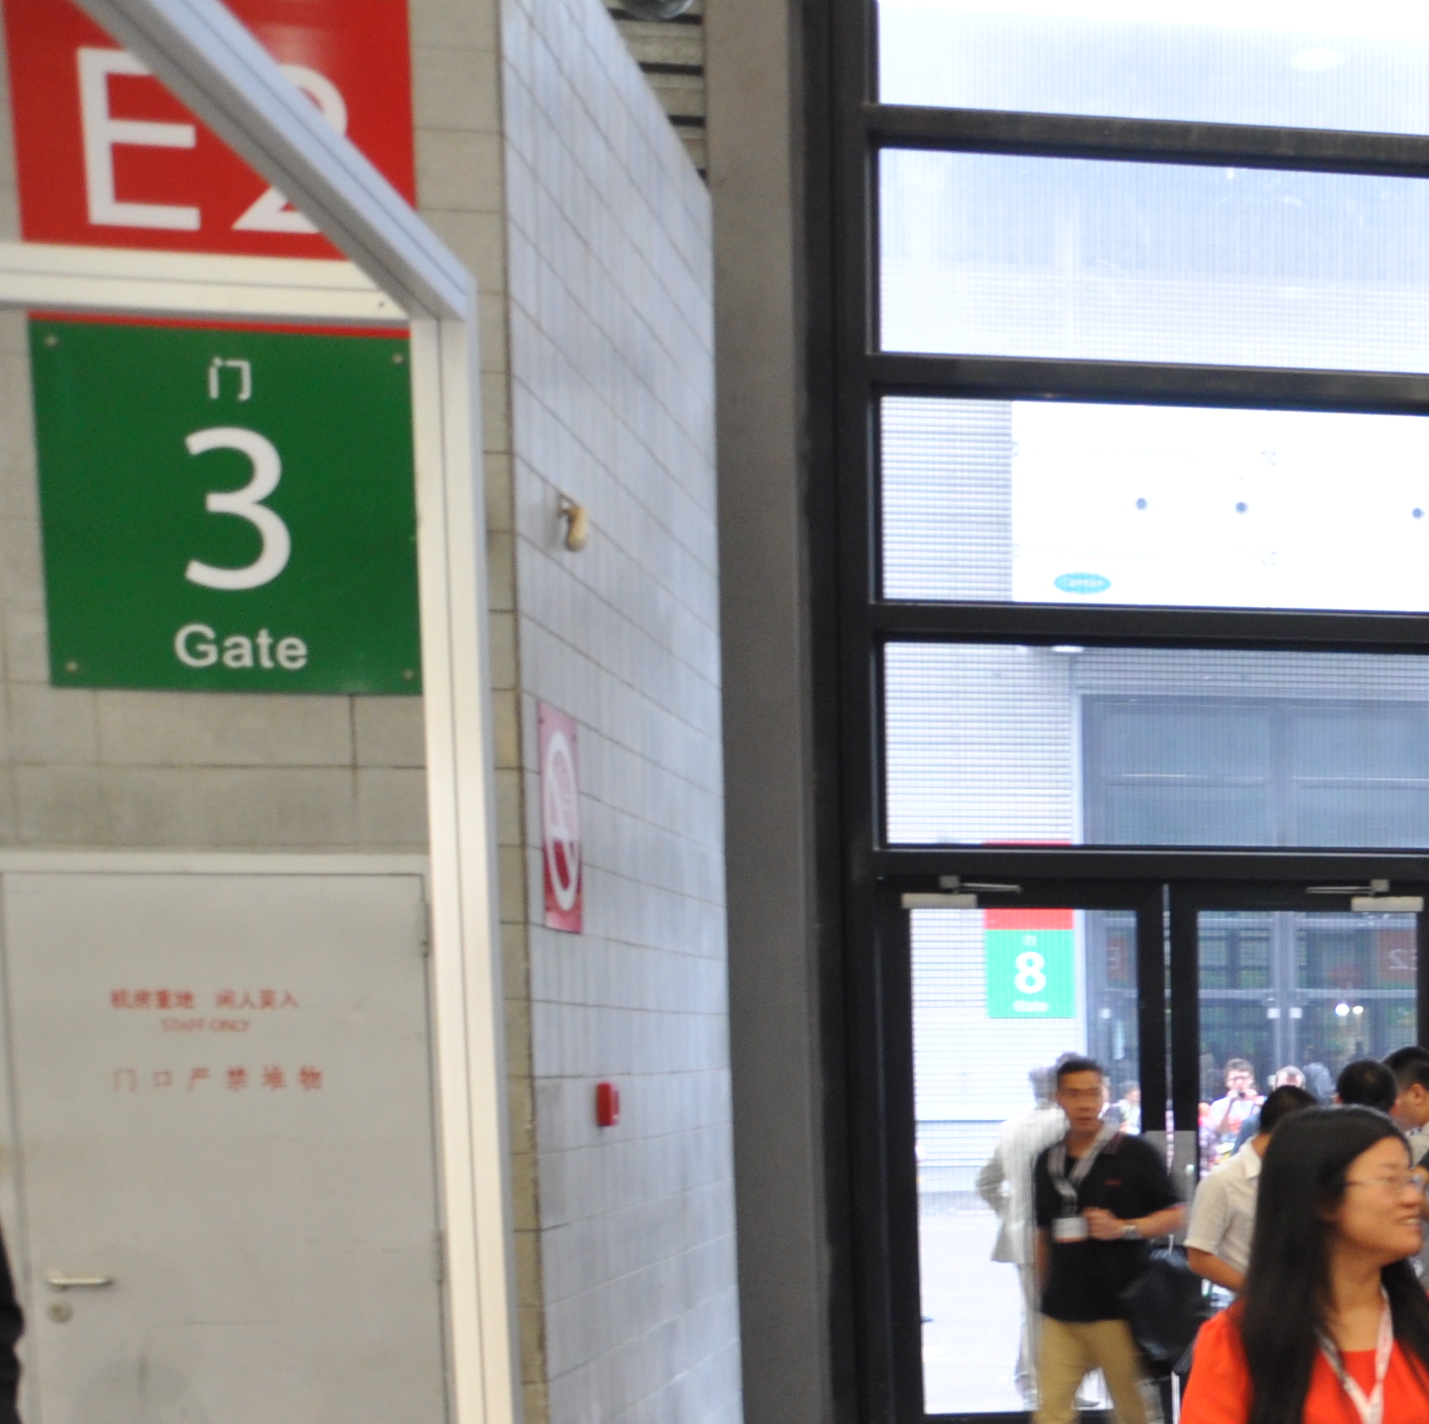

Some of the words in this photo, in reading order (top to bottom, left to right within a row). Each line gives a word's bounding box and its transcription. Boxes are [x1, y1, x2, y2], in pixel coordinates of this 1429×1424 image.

[207, 357, 252, 402] 门
[184, 426, 292, 591] 3
[173, 623, 309, 671] Gate
[1014, 951, 1047, 994] 8
